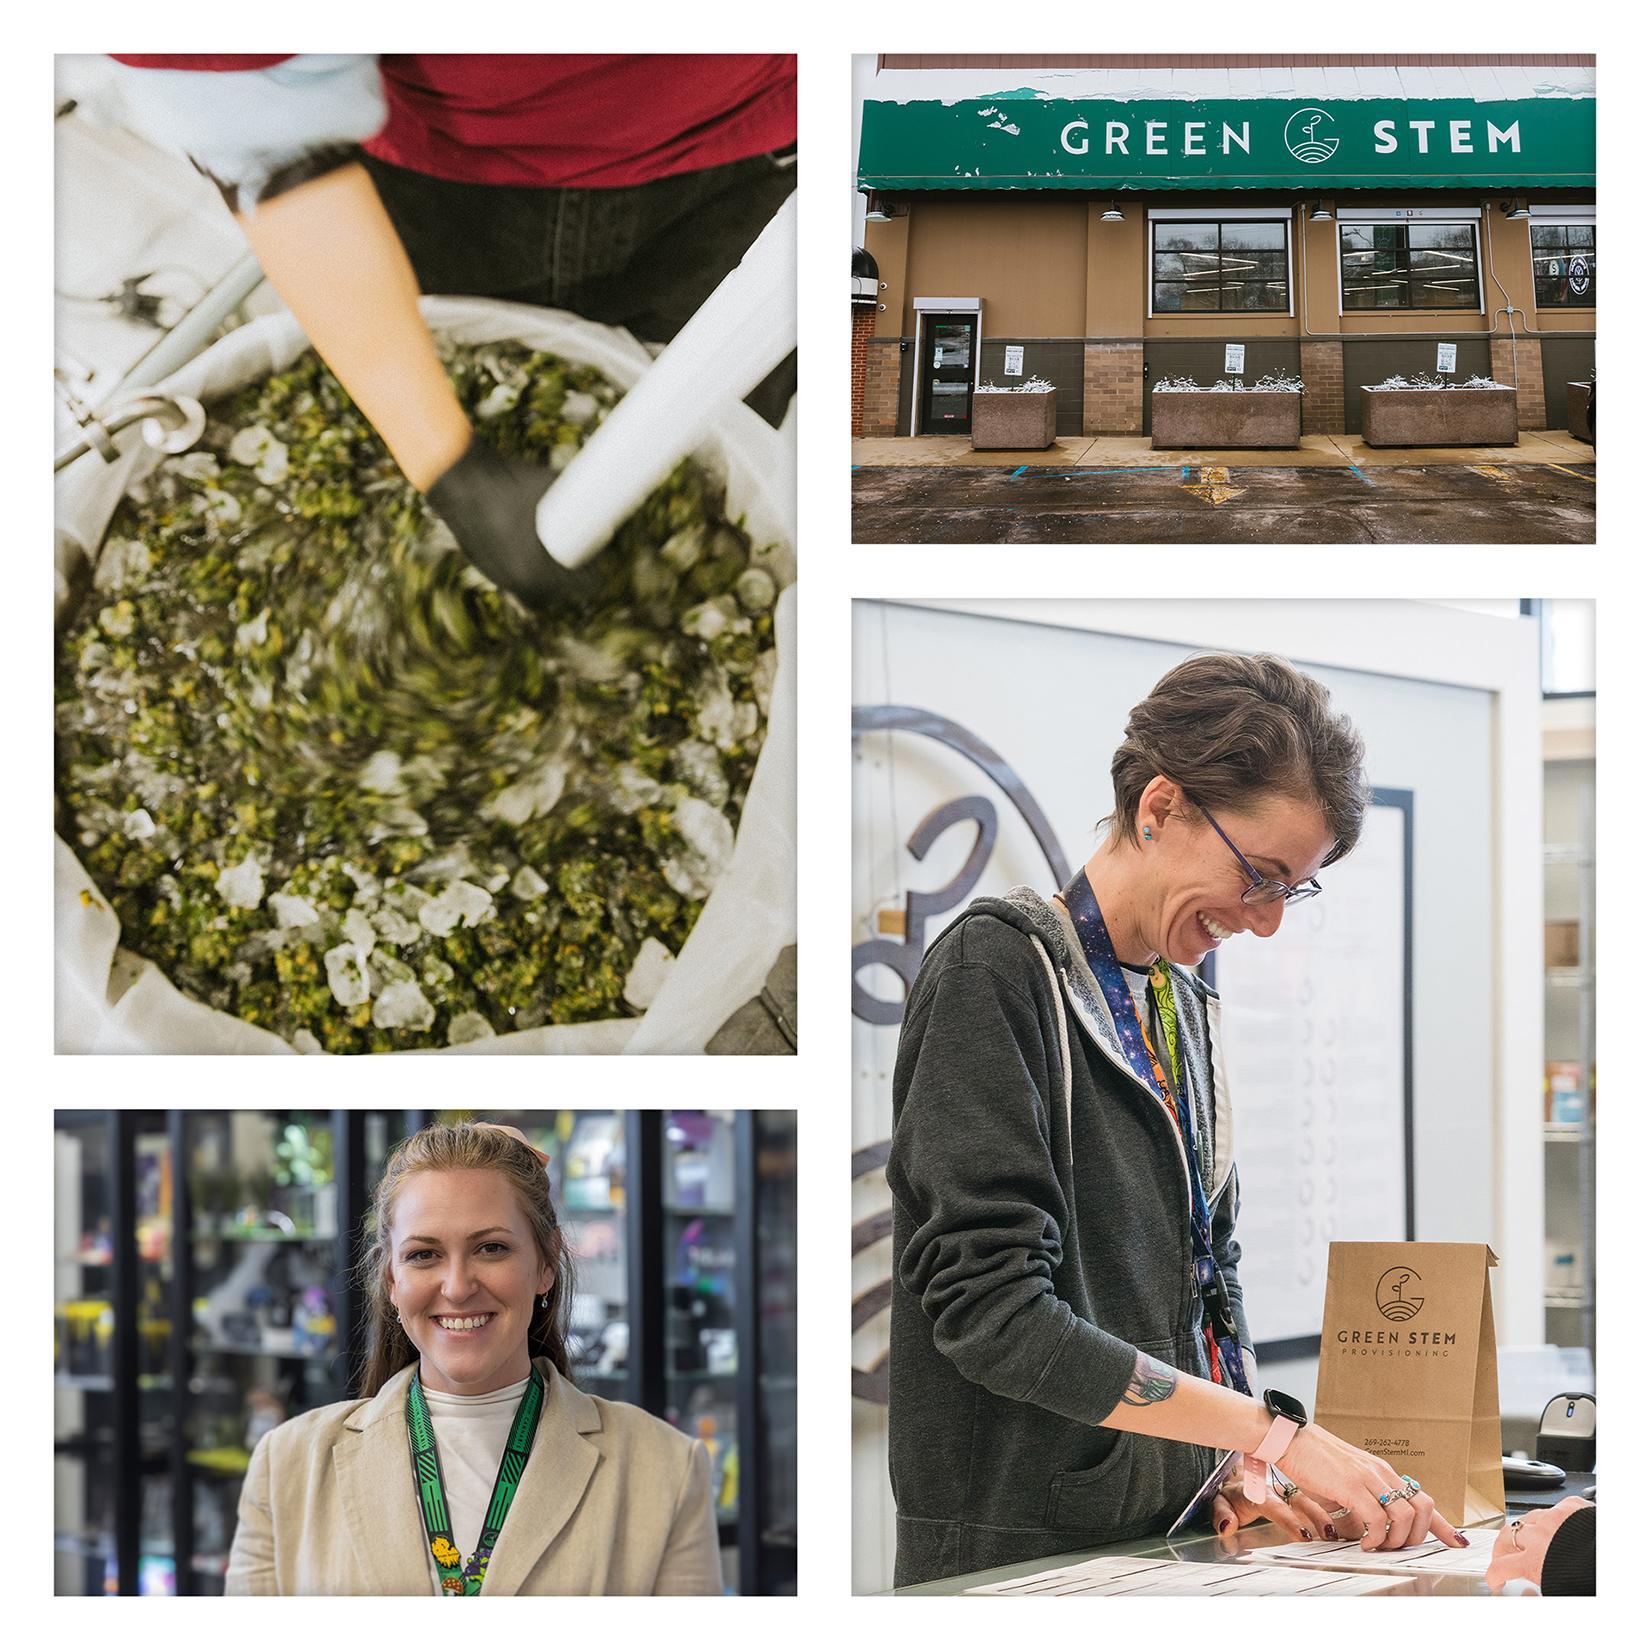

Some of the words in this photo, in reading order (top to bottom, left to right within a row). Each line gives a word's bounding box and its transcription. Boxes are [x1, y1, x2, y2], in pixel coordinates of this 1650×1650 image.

[1060, 121, 1250, 155] GREEN
[1374, 119, 1521, 154] STEM
[1337, 1330, 1399, 1345] GREEN
[1408, 1331, 1457, 1345] STEM
[1341, 1347, 1449, 1358] PROVISIONING
[1364, 1438, 1410, 1447] 269-262-4778
